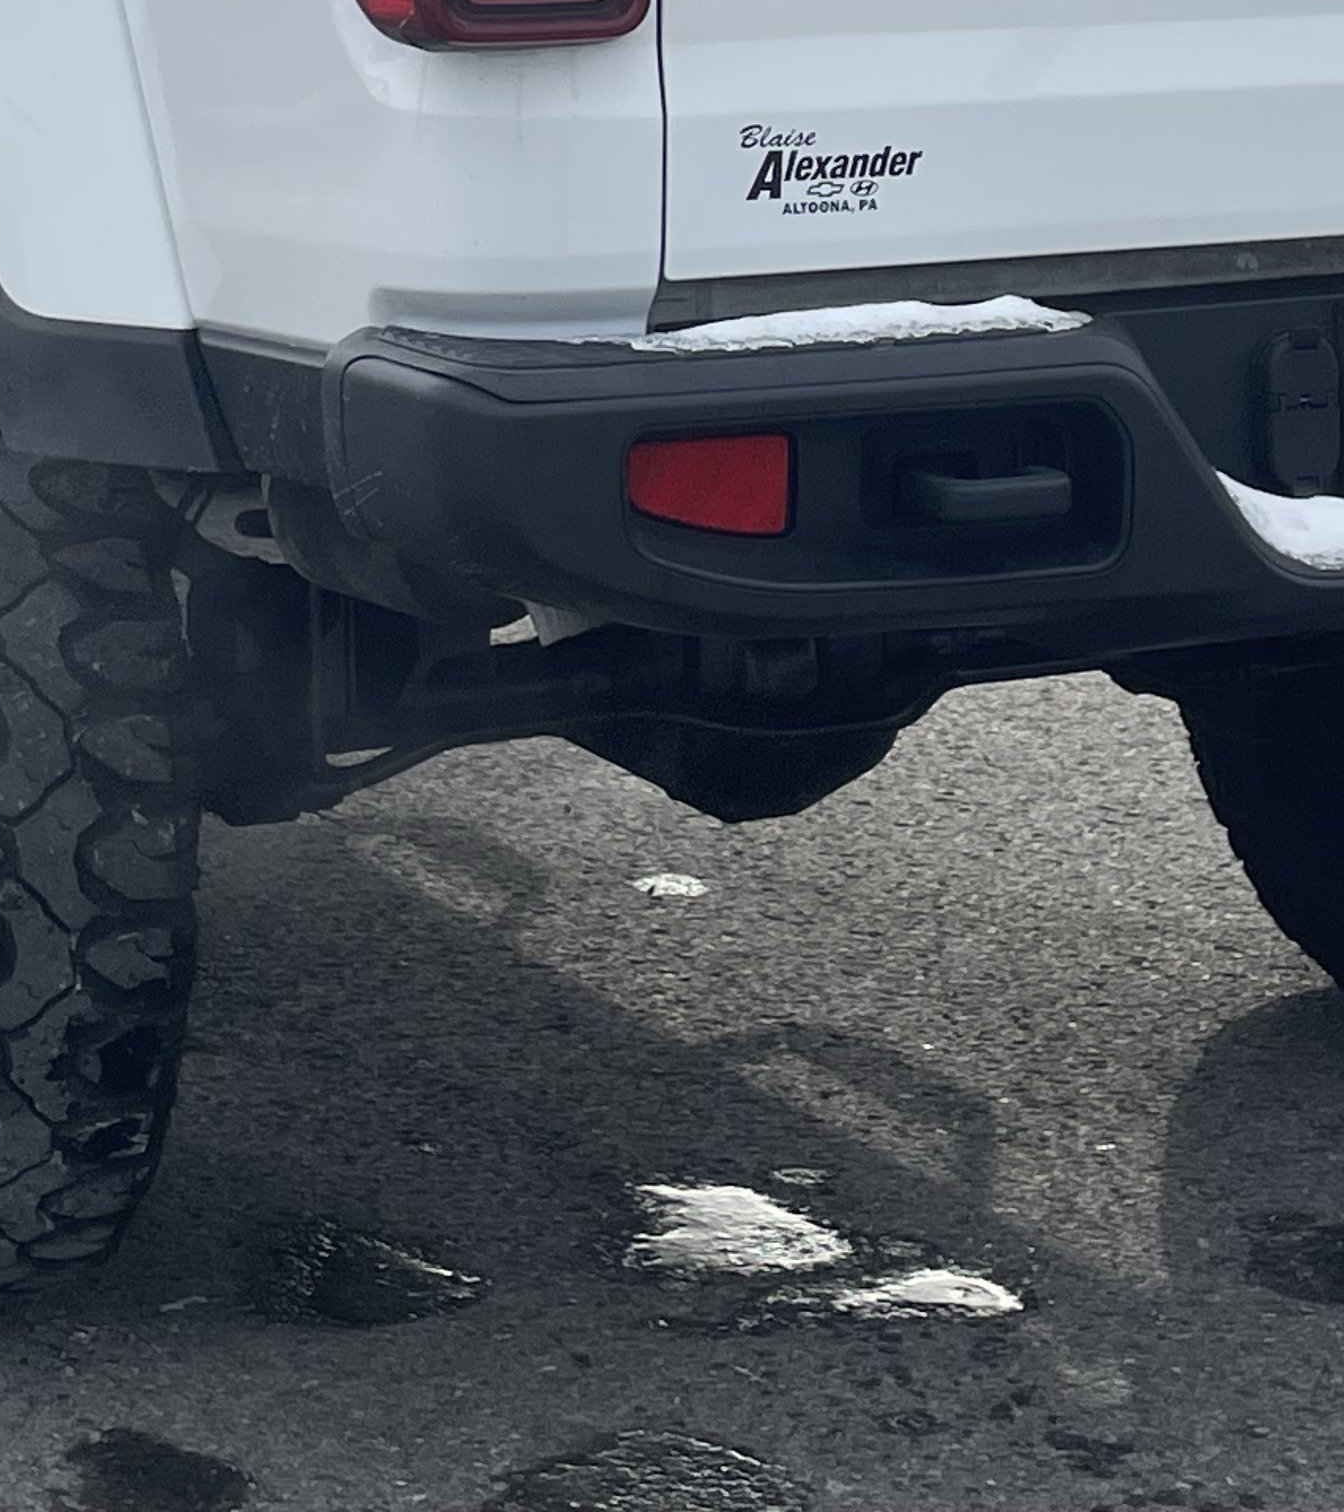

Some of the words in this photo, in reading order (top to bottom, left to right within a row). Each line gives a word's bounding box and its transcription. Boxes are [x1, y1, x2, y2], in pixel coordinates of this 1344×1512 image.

[739, 124, 817, 149] Blaise
[746, 145, 924, 201] Alexander
[782, 199, 855, 215] ALTOONA,
[859, 198, 878, 211] PA
